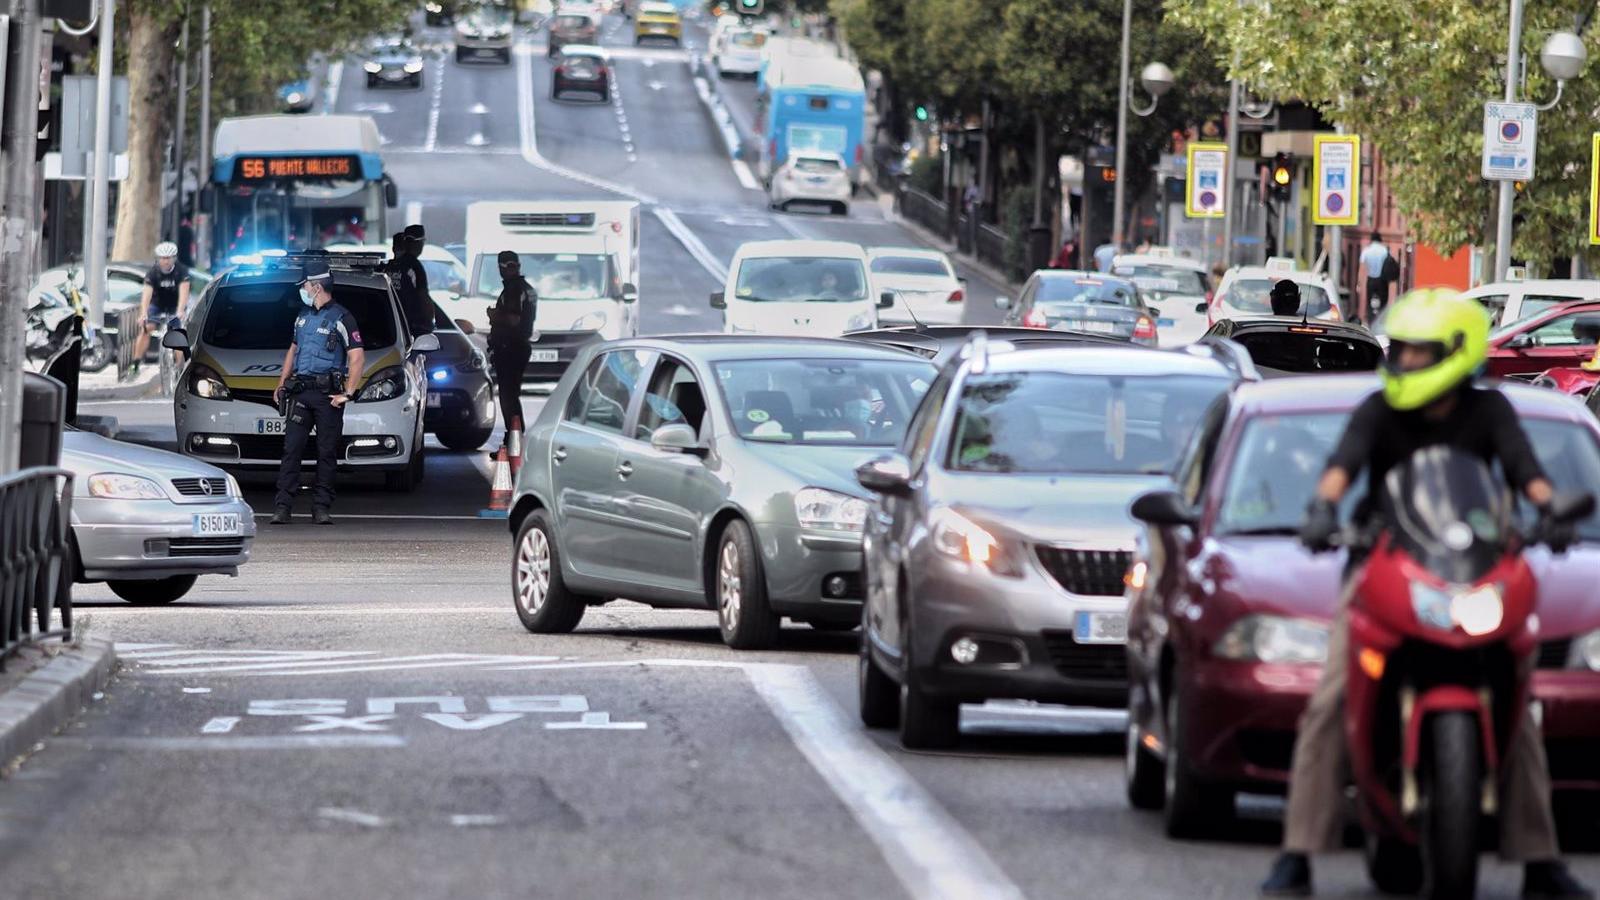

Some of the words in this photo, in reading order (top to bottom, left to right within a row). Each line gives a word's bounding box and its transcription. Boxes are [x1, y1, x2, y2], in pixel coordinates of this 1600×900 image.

[242, 159, 265, 178] 56
[269, 159, 304, 175] PUENTE
[306, 158, 349, 174] VALLECAS
[242, 364, 283, 374] PO
[201, 515, 222, 531] 6150
[202, 711, 648, 733] TAXI
